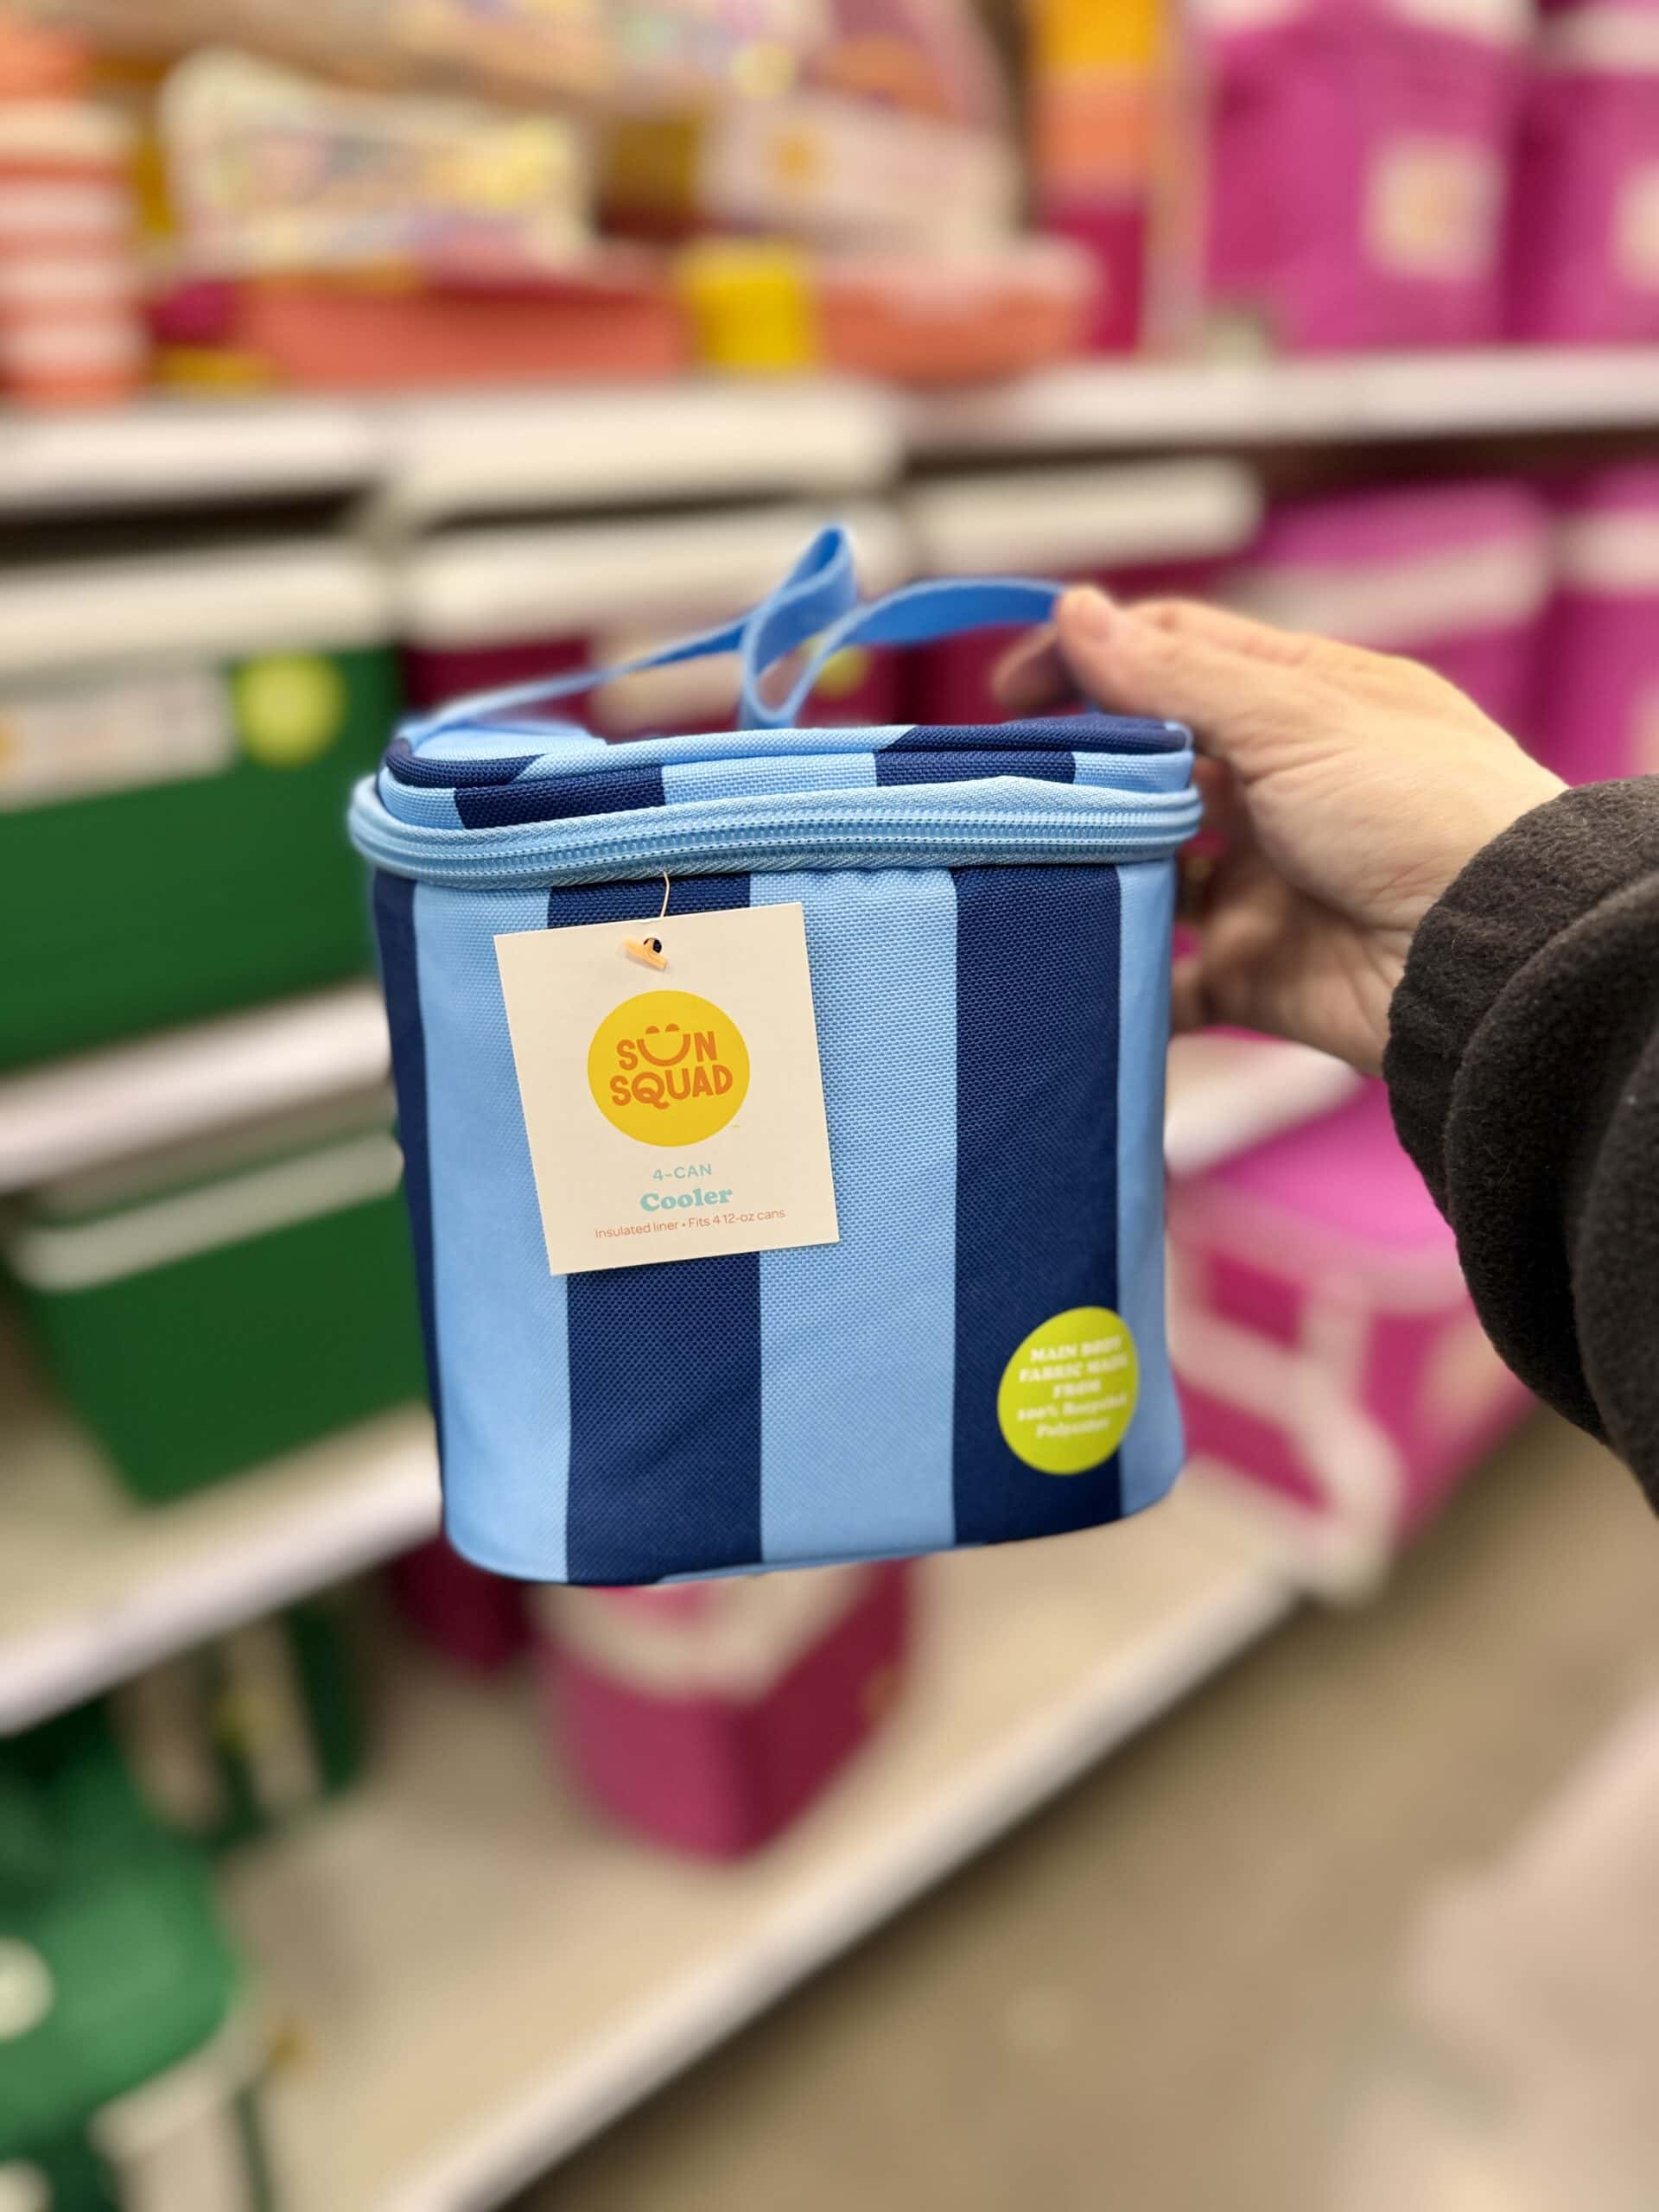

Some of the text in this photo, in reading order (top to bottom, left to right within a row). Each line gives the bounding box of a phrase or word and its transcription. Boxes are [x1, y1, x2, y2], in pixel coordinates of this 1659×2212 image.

[616, 1025, 718, 1071] SUN
[609, 1064, 734, 1109] SQUAD
[652, 1163, 713, 1181] 4-CAN
[639, 1188, 734, 1211] Cooler
[594, 1209, 786, 1238] Insulated liner Fits 4 12-oz cans
[1030, 1344, 1077, 1362] MAIN
